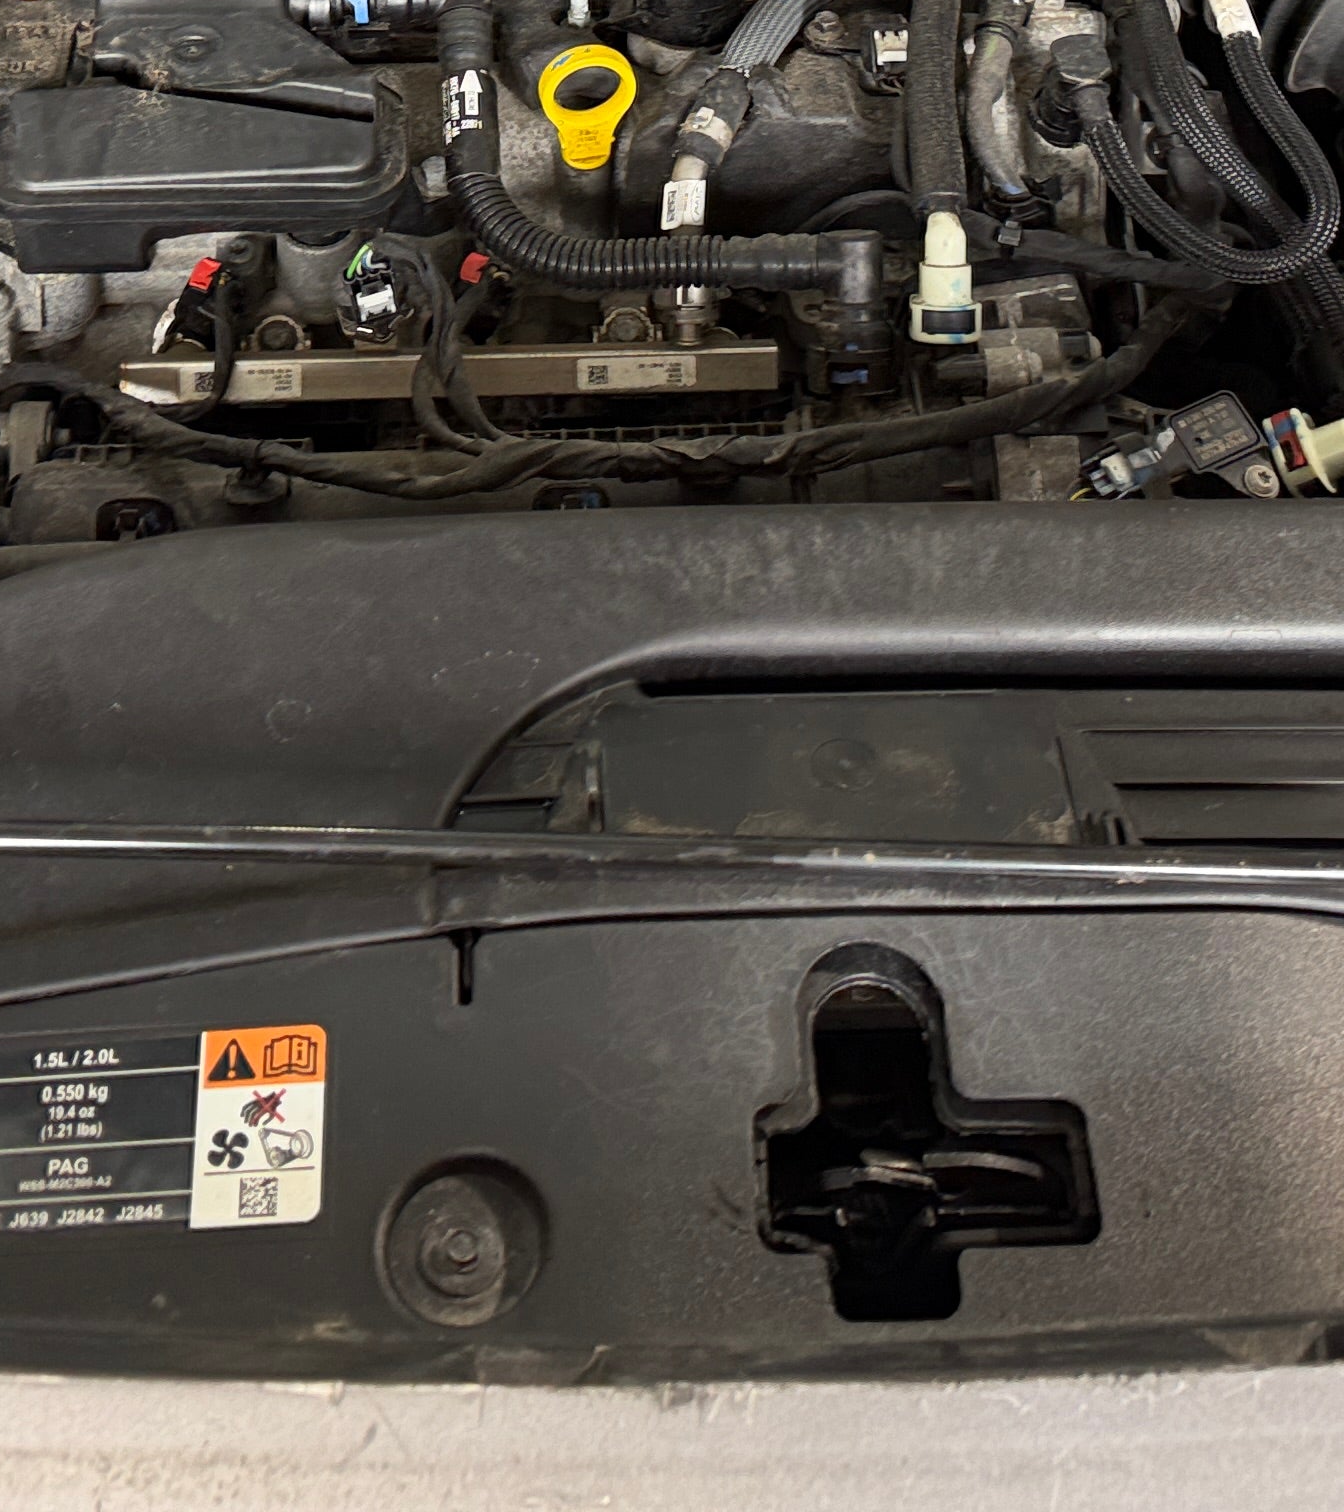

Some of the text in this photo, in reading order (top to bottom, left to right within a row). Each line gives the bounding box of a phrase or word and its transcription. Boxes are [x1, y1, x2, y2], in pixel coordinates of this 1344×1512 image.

[34, 1048, 120, 1069] 1.5L / 2.0L
[41, 1083, 109, 1103] 0.550 kg
[48, 1105, 95, 1120] 19.4 oz
[40, 1121, 103, 1143] (1.21 lbs)
[48, 1156, 89, 1176] PAG
[8, 1210, 49, 1229] J639
[56, 1207, 105, 1226] J2842
[115, 1203, 164, 1221] J2845
